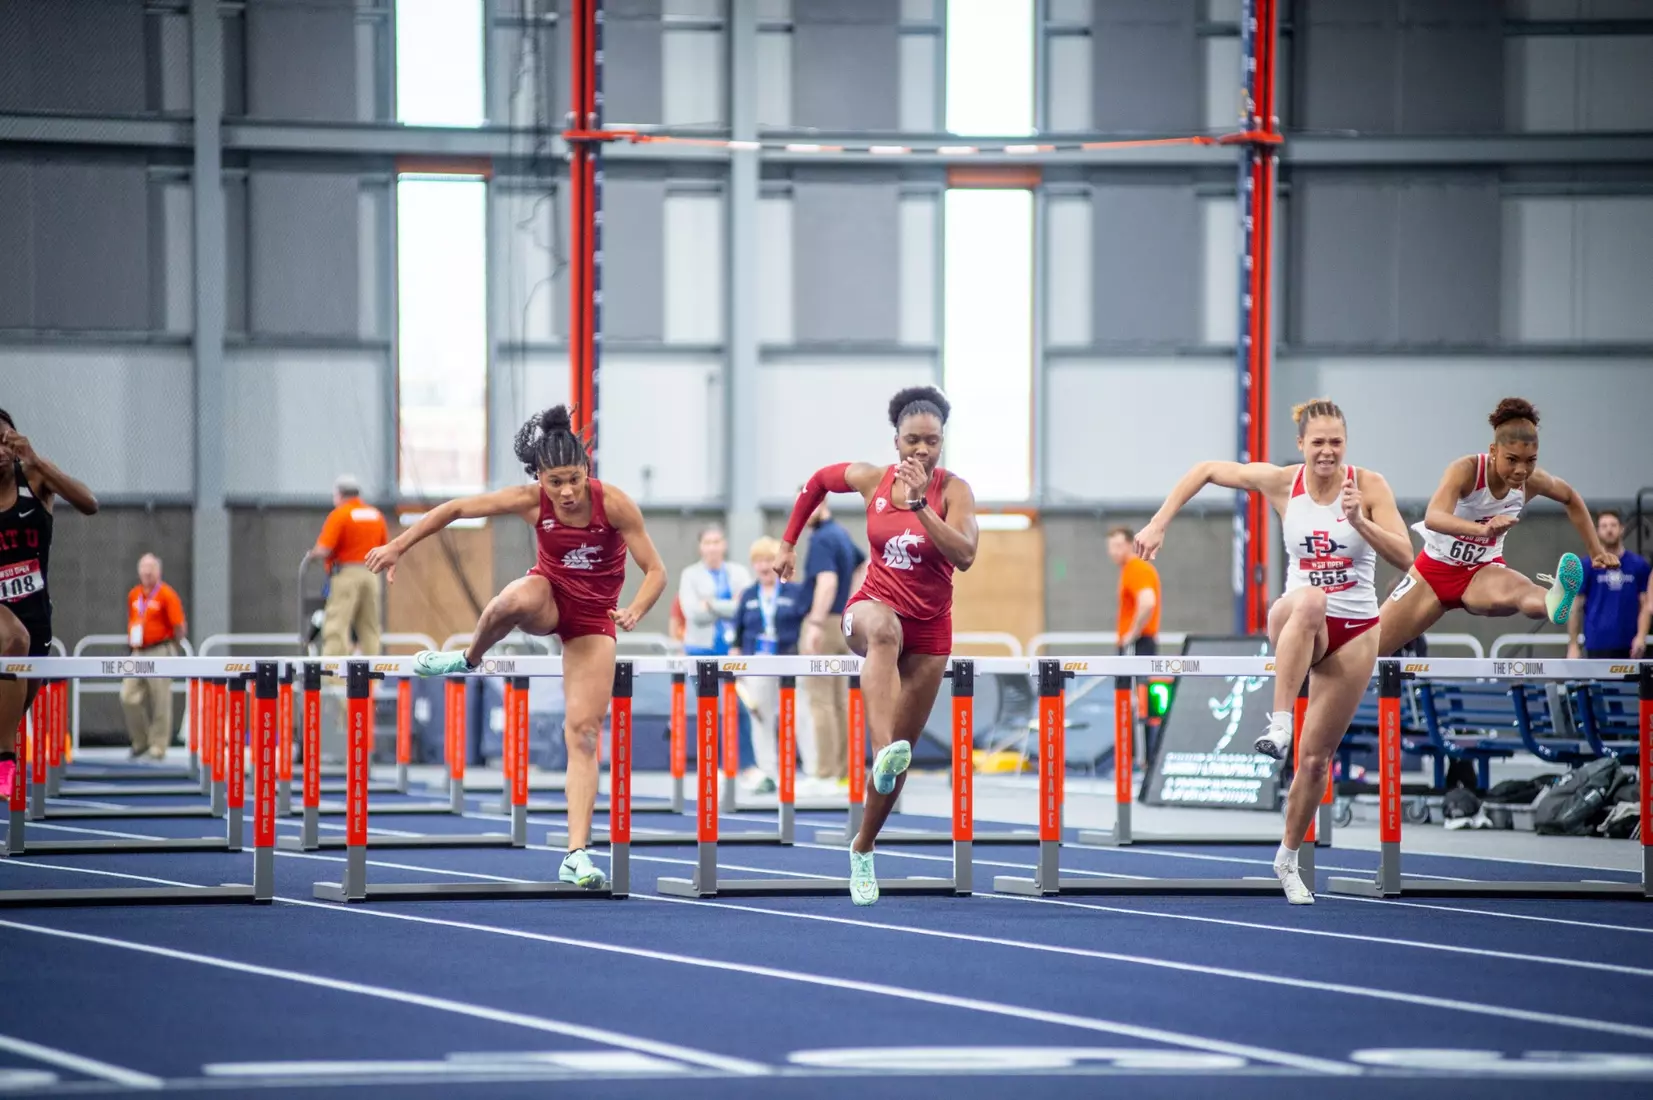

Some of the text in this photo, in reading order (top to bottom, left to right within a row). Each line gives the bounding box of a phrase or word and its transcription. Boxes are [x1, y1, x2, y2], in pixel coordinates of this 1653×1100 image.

[1450, 540, 1487, 563] 662
[1309, 570, 1348, 586] 655
[5, 663, 33, 672] GILL
[101, 660, 156, 675] THE PODIUM
[224, 663, 250, 672] GILL
[374, 663, 399, 671] GILL
[722, 662, 747, 671] GILL
[810, 659, 859, 674] THE PODIUM
[1063, 662, 1088, 671] GILL
[1151, 659, 1200, 674] THE PODIUM
[1404, 664, 1430, 672] GILL
[1493, 661, 1543, 676] THE PODIUM
[1609, 665, 1635, 674] GILL
[263, 711, 271, 834] SPOKANE
[354, 711, 363, 833] SPOKANE
[1387, 711, 1395, 830] SPOKANE
